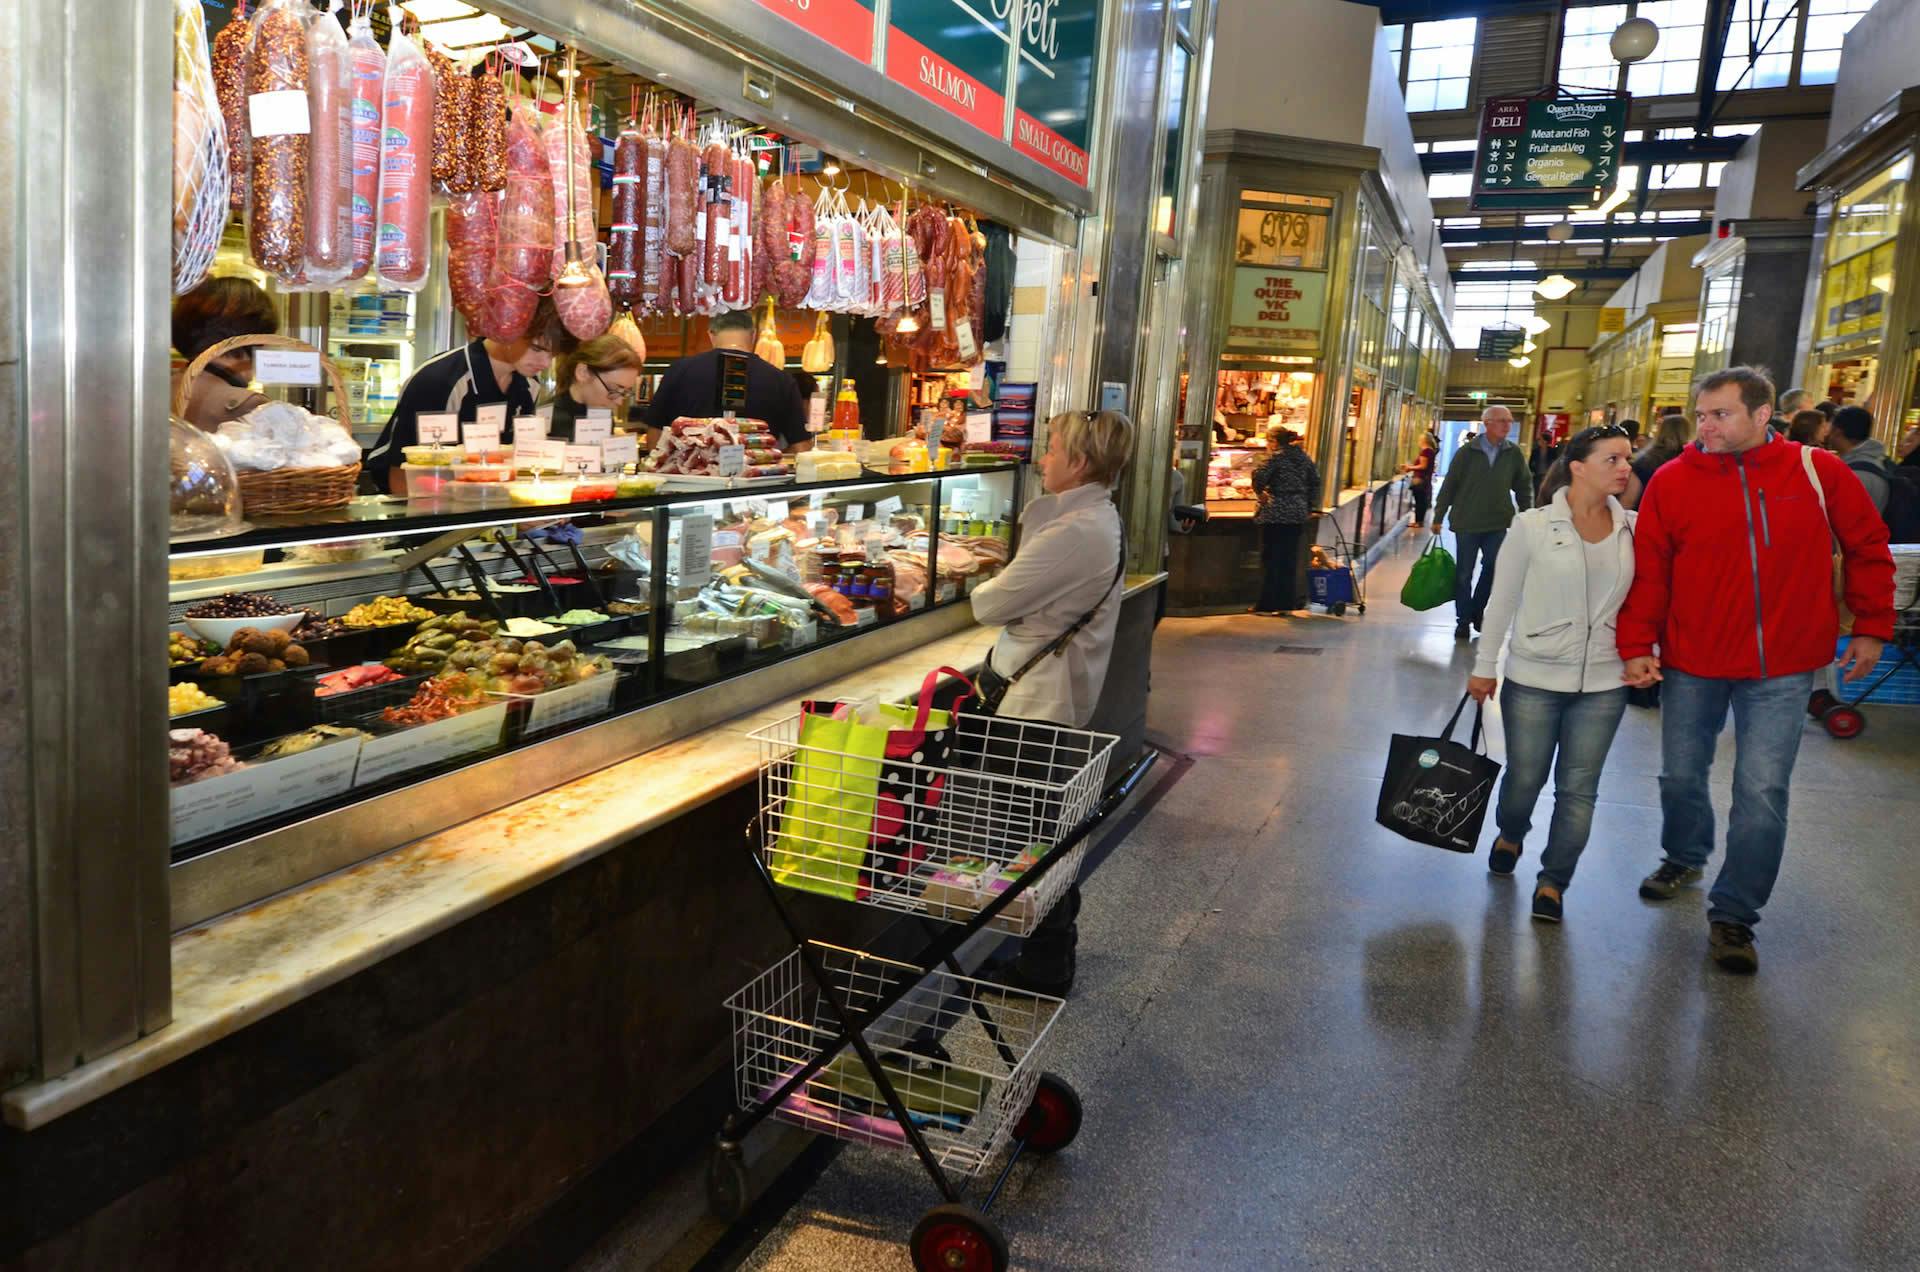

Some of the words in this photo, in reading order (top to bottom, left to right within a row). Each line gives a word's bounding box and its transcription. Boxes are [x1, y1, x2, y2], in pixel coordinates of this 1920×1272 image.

[919, 55, 976, 111] SALMON
[1547, 104, 1574, 114] Queen
[1575, 103, 1606, 112] Victoria
[1491, 117, 1521, 128] DELI
[1531, 129, 1554, 138] Meat
[1555, 128, 1571, 138] and
[1573, 128, 1590, 137] Fish
[1019, 118, 1051, 157] SMALL
[1052, 140, 1085, 175] GOODS
[1529, 144, 1549, 153] Fruit
[1550, 143, 1566, 152] and
[1567, 143, 1585, 154] Veg
[1527, 158, 1564, 169] Organics
[1525, 171, 1559, 181] General
[1560, 171, 1584, 181] Retail
[1265, 277, 1294, 288] THE
[1254, 288, 1303, 300] QUEEN
[1258, 311, 1290, 322] DELI
